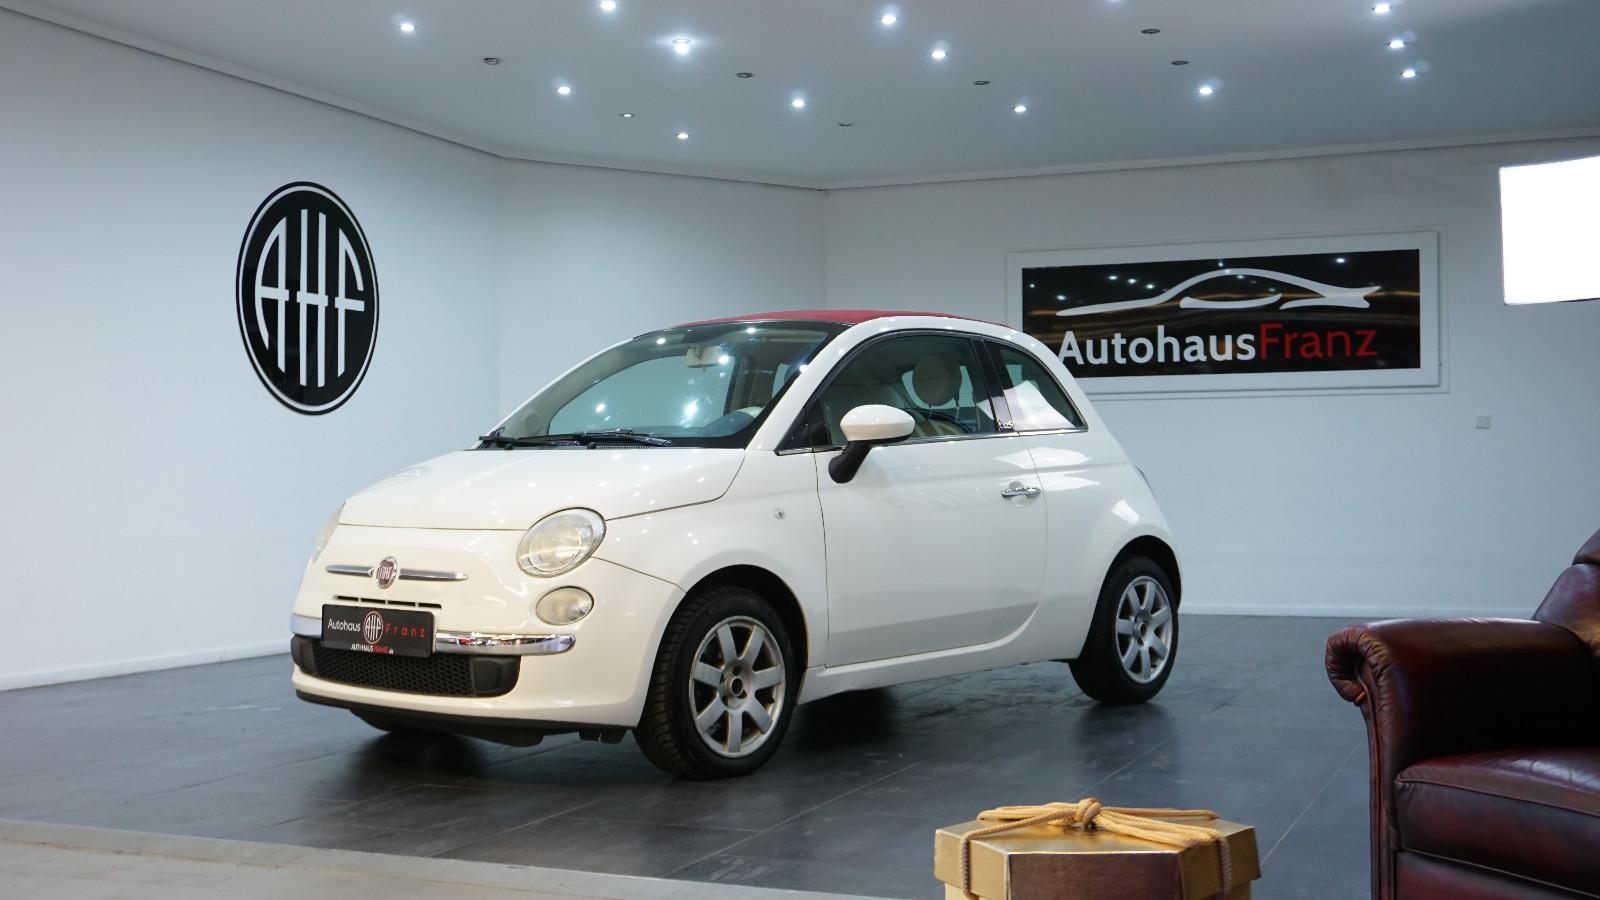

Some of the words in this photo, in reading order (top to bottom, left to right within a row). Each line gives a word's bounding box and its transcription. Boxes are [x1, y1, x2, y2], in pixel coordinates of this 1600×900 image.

[254, 208, 365, 388] AHF
[1057, 323, 1378, 366] AutohausFranz
[328, 619, 361, 632] Autohaus
[365, 614, 381, 640] AHF
[385, 623, 426, 638] Franz
